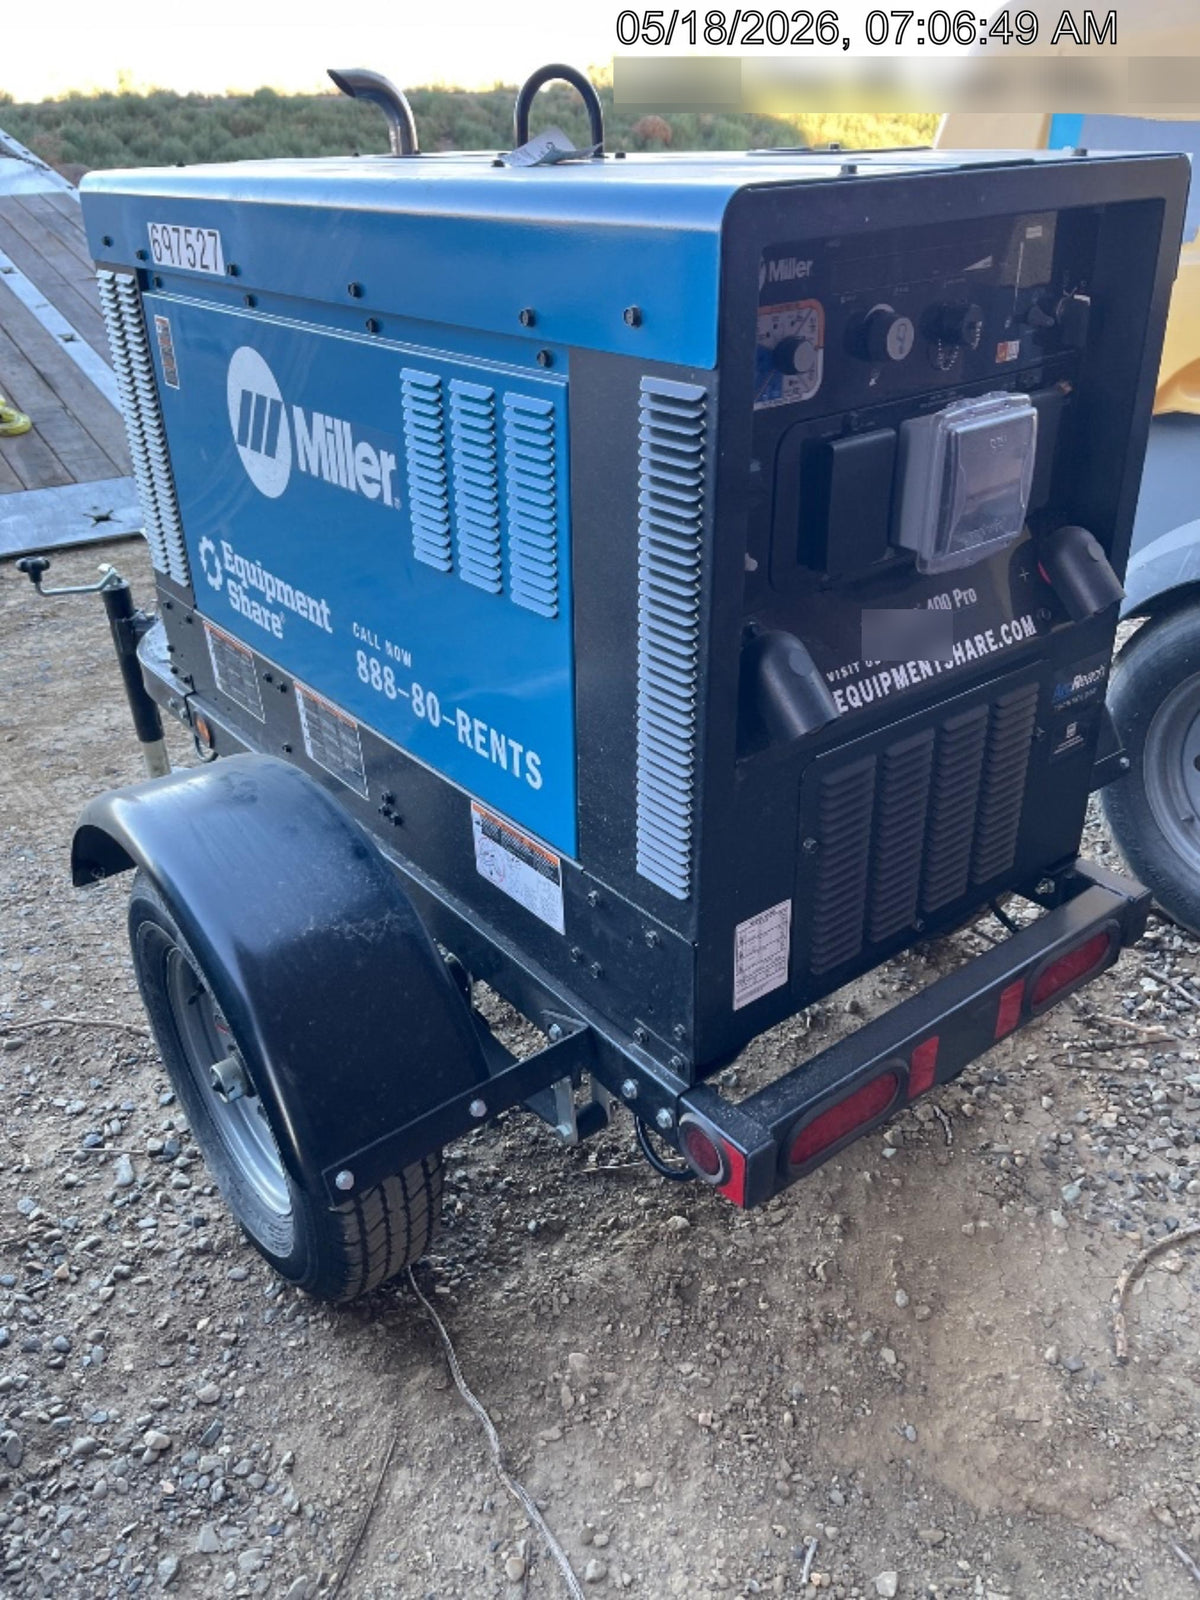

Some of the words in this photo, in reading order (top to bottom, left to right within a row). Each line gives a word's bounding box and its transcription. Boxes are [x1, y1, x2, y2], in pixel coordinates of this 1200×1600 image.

[150, 223, 219, 273] 697527
[767, 257, 815, 283] Miller
[292, 404, 398, 508] Miller
[220, 540, 334, 634] Equipment
[227, 578, 285, 640] Share
[952, 587, 978, 608] Pro
[352, 621, 381, 650] CALL
[384, 639, 412, 668] NOW
[825, 660, 861, 682] VISIT
[356, 649, 543, 791] 888-80-RENTS
